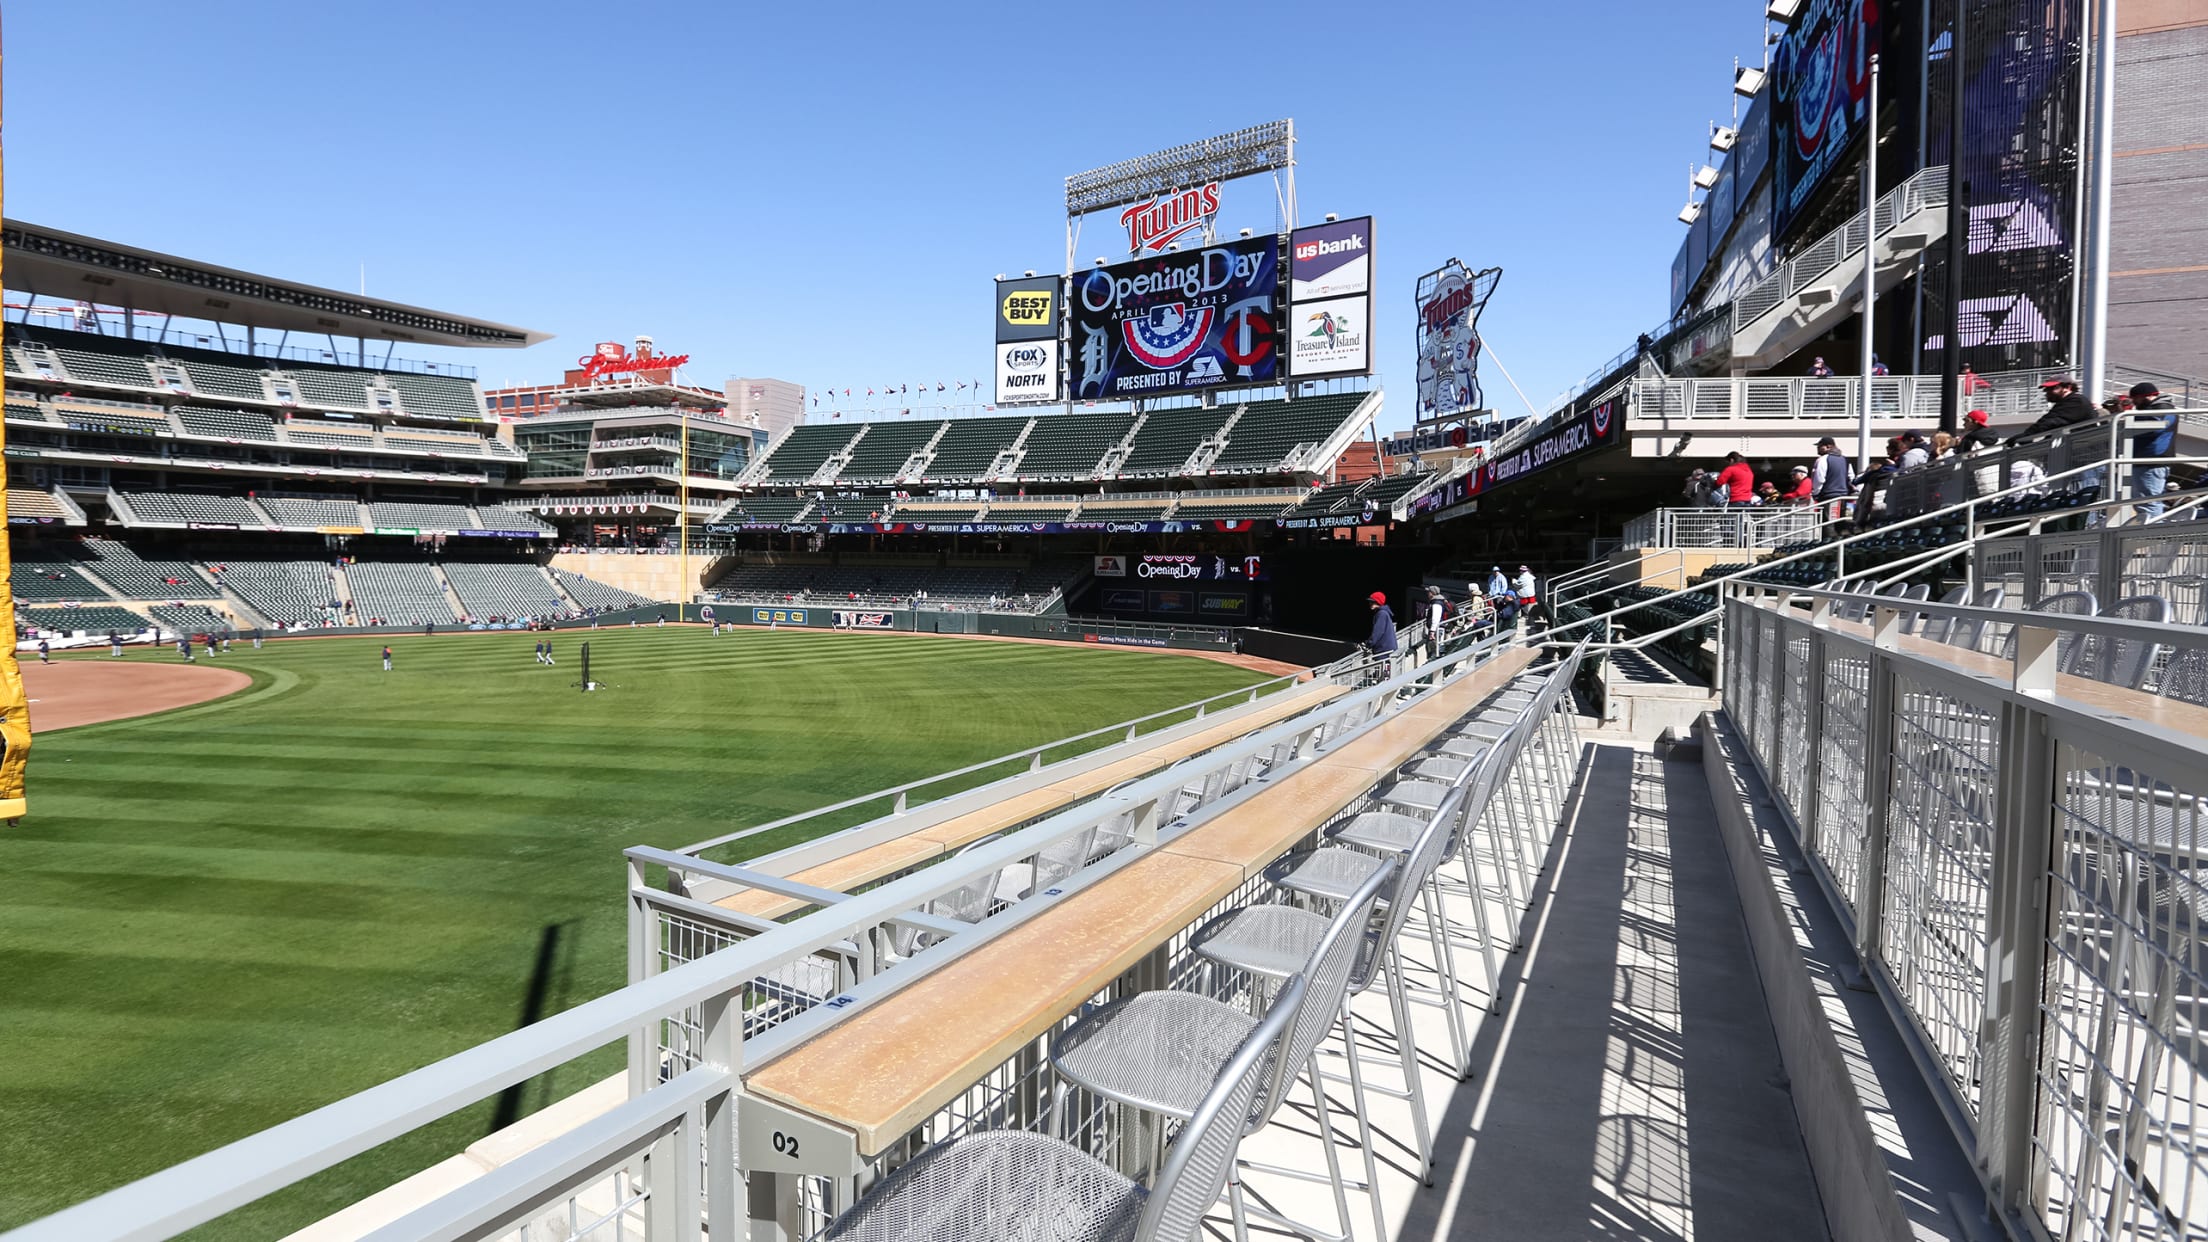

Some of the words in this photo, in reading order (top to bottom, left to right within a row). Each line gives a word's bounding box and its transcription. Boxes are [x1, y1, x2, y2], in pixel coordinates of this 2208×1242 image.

[1121, 181, 1219, 254] Twins
[1009, 297, 1049, 308] BEST
[1111, 307, 1146, 320] APRIL
[1192, 294, 1228, 307] 2013
[1422, 282, 1473, 336] Twins
[1010, 309, 1045, 319] BUY
[1296, 339, 1328, 352] Treasure
[1336, 333, 1360, 347] Island
[578, 350, 689, 378] Budweiser
[1014, 349, 1038, 361] FOX
[1006, 374, 1046, 387] NORTH
[1116, 374, 1165, 391] PRESENTED
[1169, 370, 1182, 385] BY
[1184, 375, 1227, 386] SUPERAMERICA
[1383, 432, 1449, 455] TARGET
[1534, 421, 1589, 466] SUPERAMERICA
[1320, 515, 1360, 527] SUPERAMERICA
[1137, 562, 1180, 579] Opening
[1180, 563, 1201, 579] Day
[1202, 598, 1244, 609] SUBWAY
[827, 997, 853, 1007] 14
[773, 1131, 799, 1159] 02
